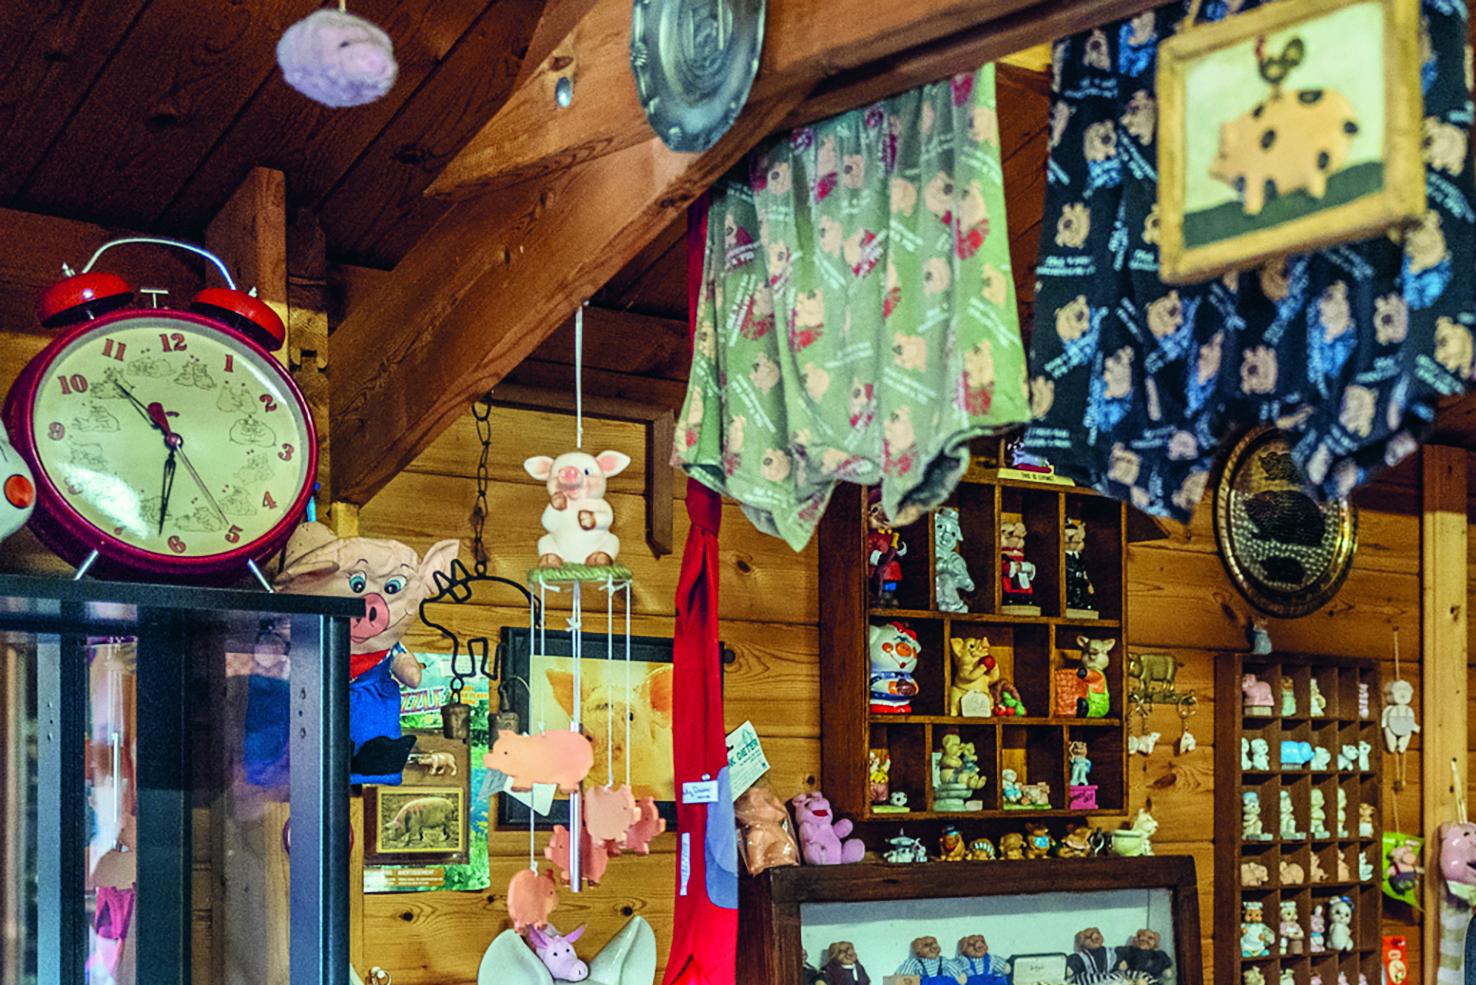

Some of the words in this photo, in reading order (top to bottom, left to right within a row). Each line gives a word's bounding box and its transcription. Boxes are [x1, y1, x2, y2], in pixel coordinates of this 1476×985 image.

[102, 338, 127, 362] 11
[159, 332, 188, 353] 12
[224, 354, 234, 373] 1
[57, 373, 88, 395] 10
[259, 394, 277, 413] 2
[47, 421, 65, 441] 9
[277, 443, 295, 462] 3
[262, 490, 277, 510] 4
[224, 524, 243, 544] 5
[167, 535, 187, 554] 6
